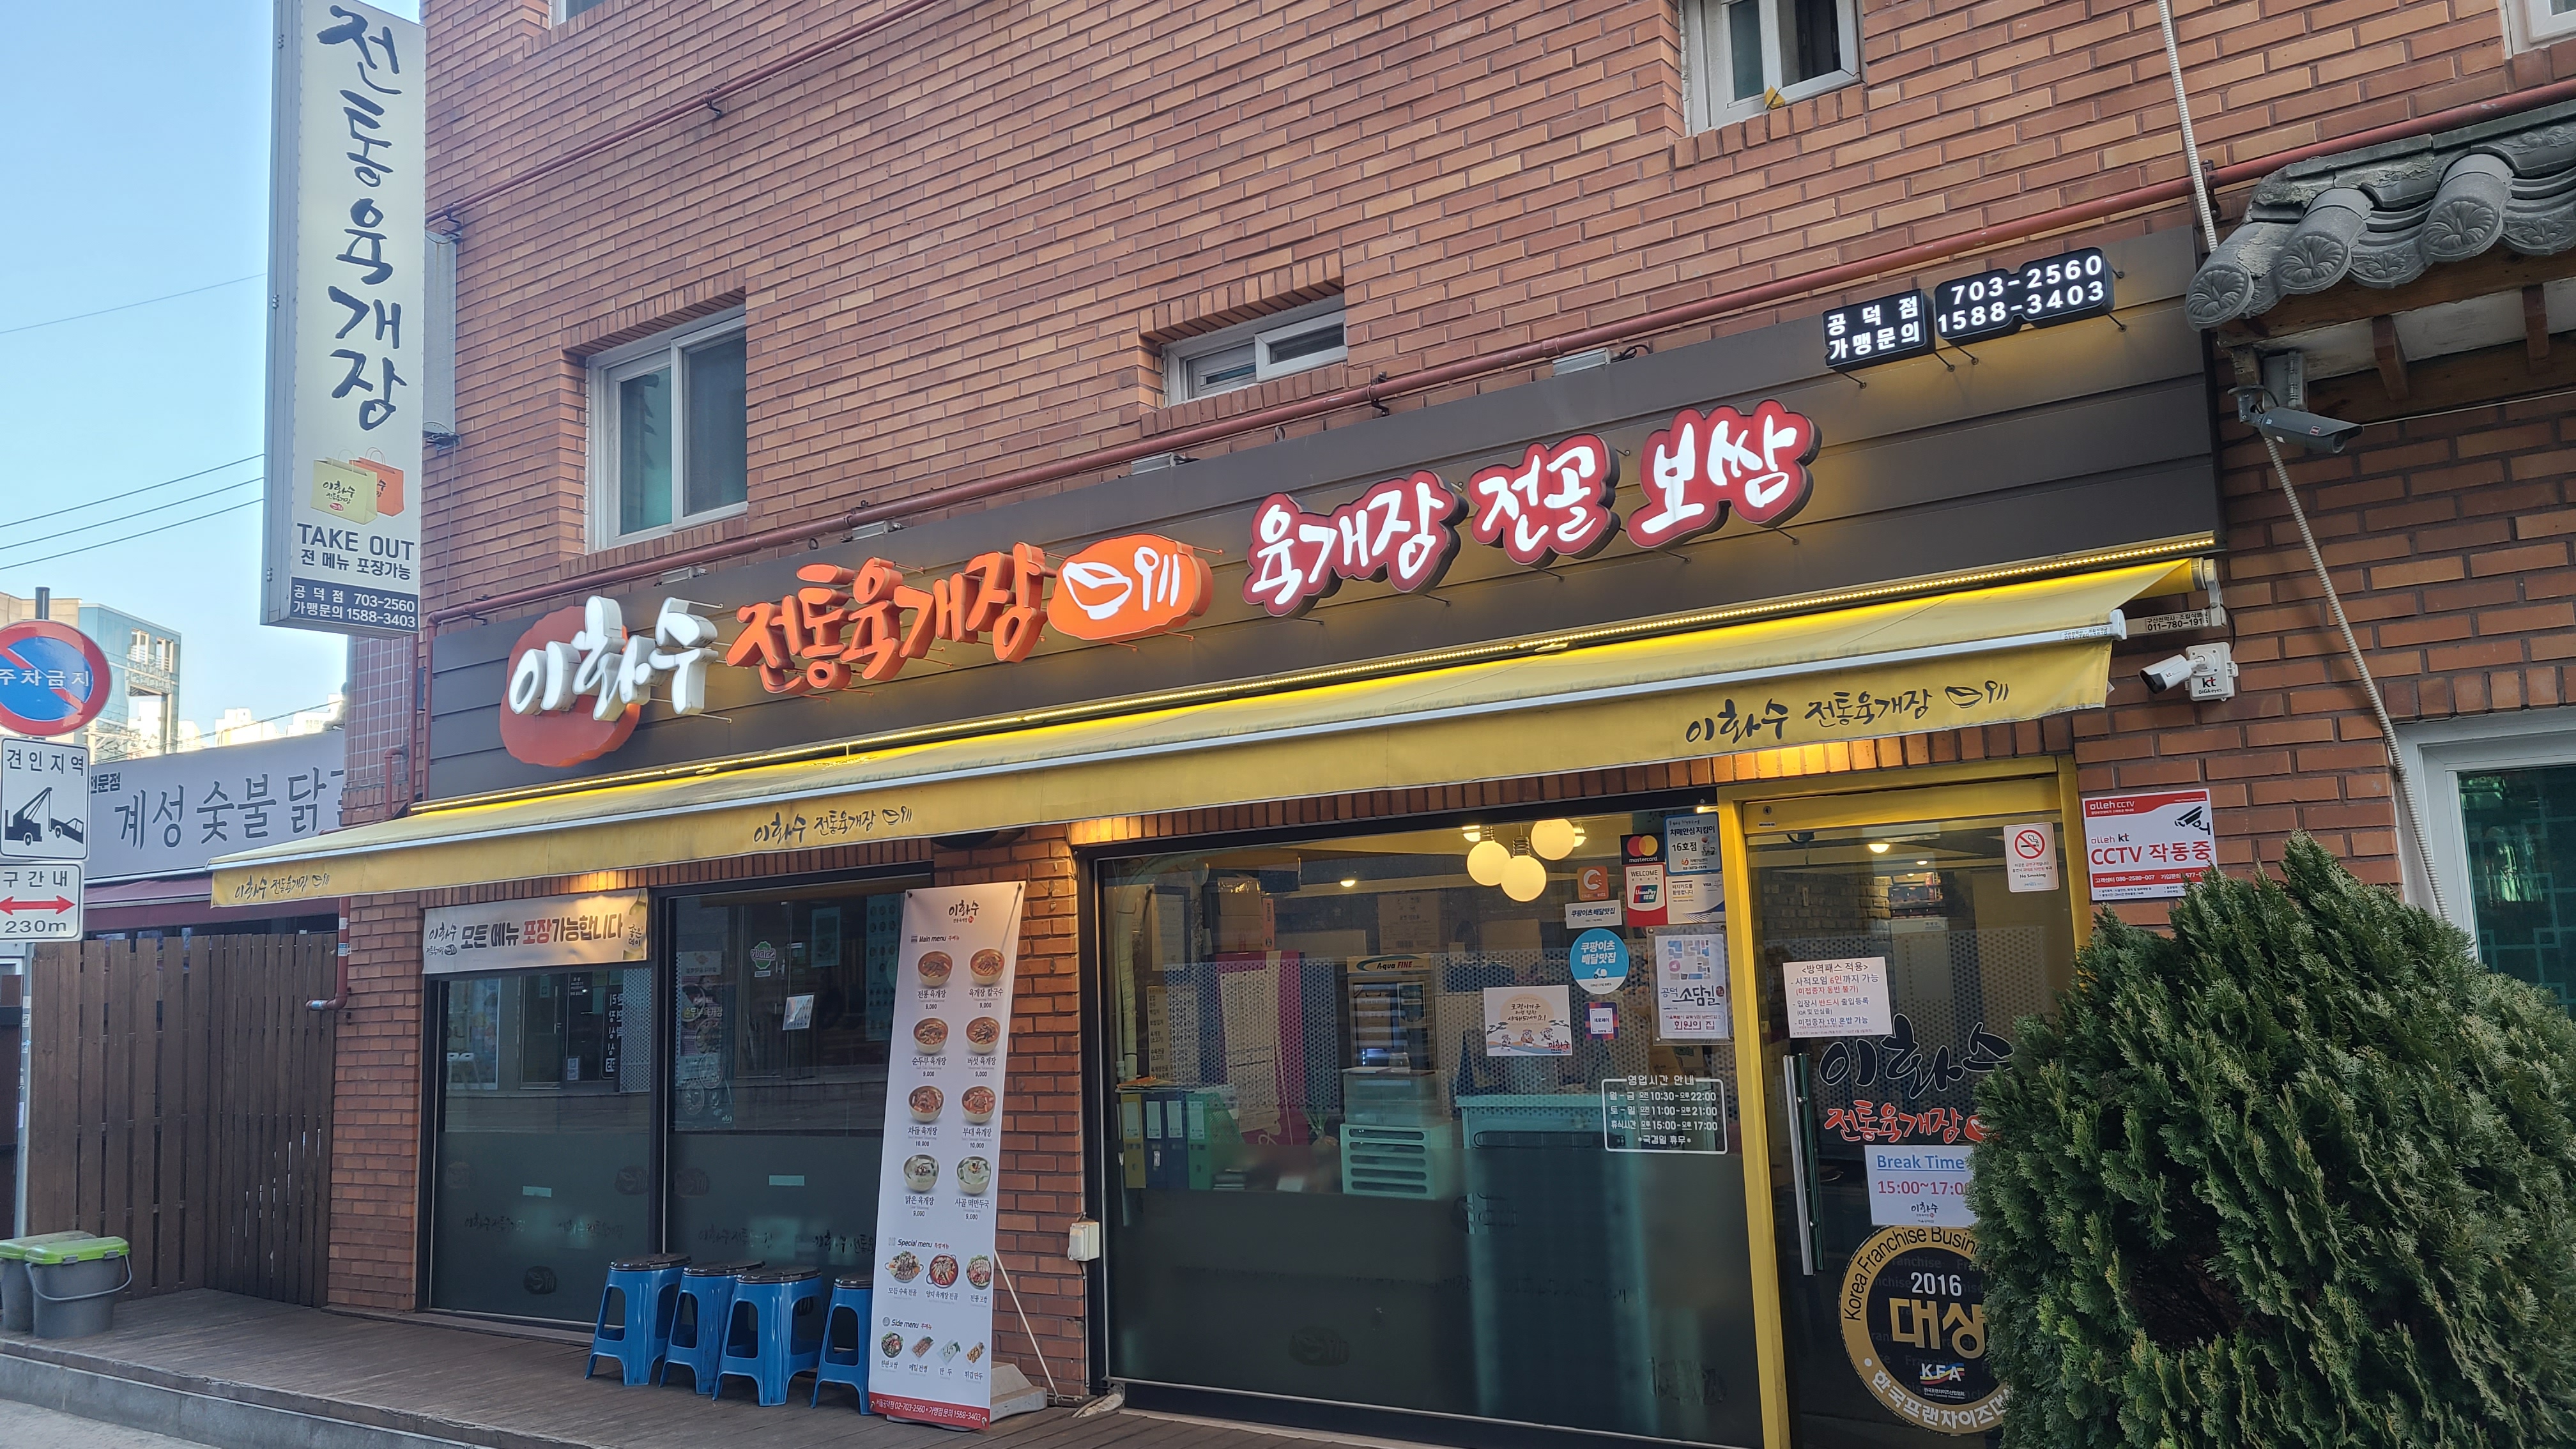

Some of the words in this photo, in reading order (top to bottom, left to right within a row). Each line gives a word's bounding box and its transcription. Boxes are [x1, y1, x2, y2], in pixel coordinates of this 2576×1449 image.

[316, 4, 408, 431] 전통육개장
[1828, 295, 1919, 337] 공덕점
[1951, 255, 2102, 306] 703-2560
[1829, 321, 1920, 360] 가맹문의
[1937, 280, 2104, 334] 1588-3403
[1252, 481, 1445, 605] 육개장
[1478, 445, 1597, 553] 전골
[1642, 413, 1797, 534] 보쌈
[297, 523, 358, 552] TAKE
[369, 535, 414, 561] OUT
[301, 549, 314, 565] 전
[322, 552, 349, 571] 메뉴
[356, 557, 410, 580] 포장가능
[294, 584, 343, 603] 공덕점
[354, 593, 414, 612] 703-2560
[294, 601, 342, 618] 가맹문의
[346, 608, 415, 627] 1588-3403
[509, 595, 718, 716] 이화수
[726, 542, 1056, 695] 전통육개장
[0, 670, 89, 687] 주차금지
[2202, 677, 2216, 688] kt
[1685, 698, 1789, 744] 이화수
[1805, 688, 1933, 727] 전통육개장
[6, 748, 85, 776] 견인지역
[2090, 801, 2115, 810] olleh
[754, 812, 806, 845] 이화수
[814, 809, 877, 836] 전통육개장
[1670, 827, 1695, 836] 치매안심
[1696, 825, 1715, 834] 지킴이
[2091, 836, 2115, 844] olleh
[2118, 833, 2129, 842] kt
[1672, 842, 1697, 851] 16호점
[2091, 846, 2142, 865] CCTV
[2149, 840, 2211, 862] 작동중
[3, 870, 68, 887] 구간내
[948, 900, 979, 917] 이화수
[1593, 907, 1615, 916] 배달맛집
[4, 919, 67, 934] 230m
[461, 924, 489, 949] 모든
[491, 921, 519, 947] 메뉴
[523, 912, 622, 945] 포장가능합니다
[1581, 940, 1615, 953] 쿠팡이츠
[1581, 952, 1616, 965] 배달맛집
[1802, 963, 1843, 974] <방역패스
[1845, 962, 1868, 972] 적용>
[1795, 976, 1828, 986] 사적모임
[1830, 974, 1859, 985] 6인까지
[1862, 973, 1879, 983] 가능
[917, 990, 929, 998] 전통
[930, 989, 946, 998] 육개장
[969, 988, 985, 997] 육개장
[1661, 986, 1678, 997] 공덕
[1672, 985, 1720, 1006] 소담길
[1796, 986, 1825, 995] (미접종자
[1843, 985, 1859, 993] 불가)
[1819, 999, 1839, 1007] 반드시
[1675, 1021, 1701, 1030] 회원의
[1706, 1021, 1715, 1030] 집
[1798, 1018, 1825, 1026] 미접종자
[912, 1057, 929, 1066] 순두부
[930, 1056, 947, 1066] 육개장
[967, 1057, 979, 1066] 버섯
[979, 1056, 996, 1066] 육개장
[1628, 1075, 1668, 1085] 영업시간
[1674, 1075, 1694, 1085] 안내
[1609, 1091, 1617, 1101] 월
[1627, 1091, 1634, 1101] 금
[1650, 1092, 1675, 1101] 10:30
[1691, 1092, 1716, 1101] 22:00
[1610, 1107, 1618, 1115] 토
[1628, 1106, 1635, 1115] 일
[1652, 1107, 1675, 1116] 11:00
[1692, 1107, 1717, 1116] 21:00
[1611, 1120, 1636, 1130] 휴식시간
[1652, 1121, 1676, 1130] 15:00
[1694, 1121, 1717, 1130] 17:00
[1824, 1100, 1963, 1144] 전통육개장
[921, 1126, 938, 1135] 육개장
[962, 1128, 974, 1136] 부대
[976, 1128, 992, 1137] 육개장
[1643, 1135, 1667, 1144] 국경일
[1670, 1135, 1685, 1144] 휴무
[1877, 1154, 1921, 1169] Break
[1924, 1155, 1965, 1169] Time
[918, 1196, 934, 1206] 육개장
[898, 1239, 917, 1247] Special
[1844, 1273, 1867, 1321] Korea
[1857, 1228, 1927, 1275] Franchise
[1910, 1271, 1962, 1296] 2016
[1889, 1297, 1986, 1359] 대상
[1920, 1363, 1962, 1382] KFA
[894, 1402, 925, 1413] 02-703-2560
[954, 1410, 981, 1421] 1588-3403
